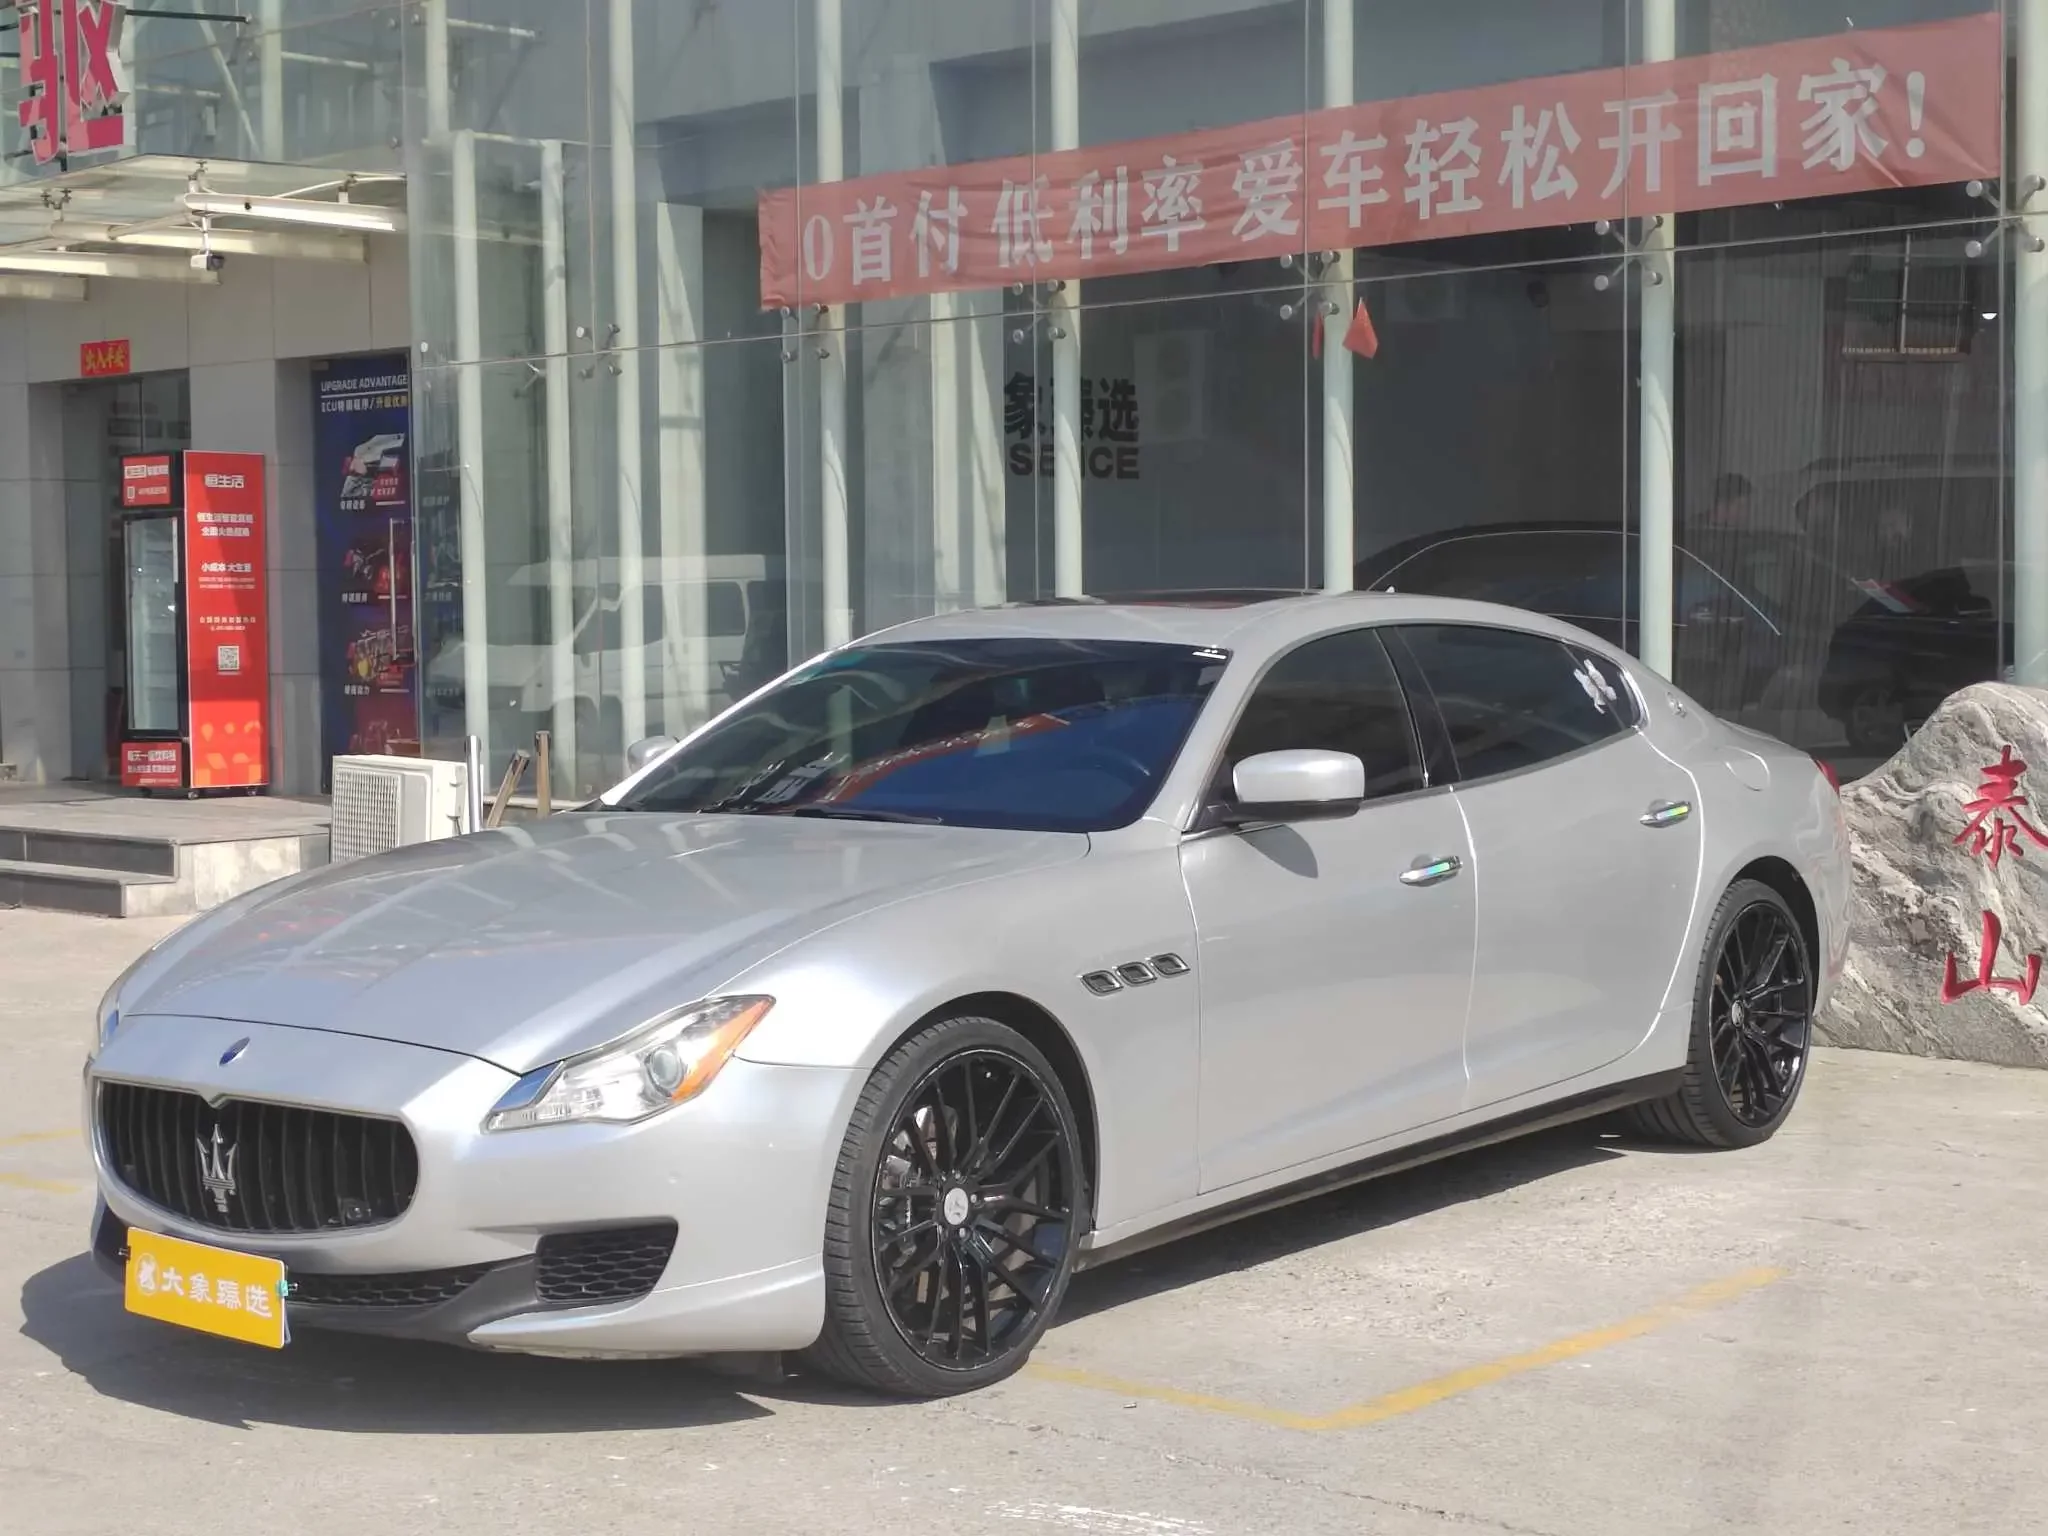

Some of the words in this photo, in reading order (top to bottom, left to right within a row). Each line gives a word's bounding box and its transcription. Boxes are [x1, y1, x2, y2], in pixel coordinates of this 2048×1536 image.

[801, 189, 969, 286] 0首付
[989, 155, 1206, 268] 低利率
[1232, 57, 1928, 242] 爱车轻松开回家!
[320, 378, 358, 392] UPGRADE
[359, 373, 408, 389] ADVANTAGE
[1940, 743, 2048, 1006] 泰山
[161, 1265, 272, 1320] 大象臻选
